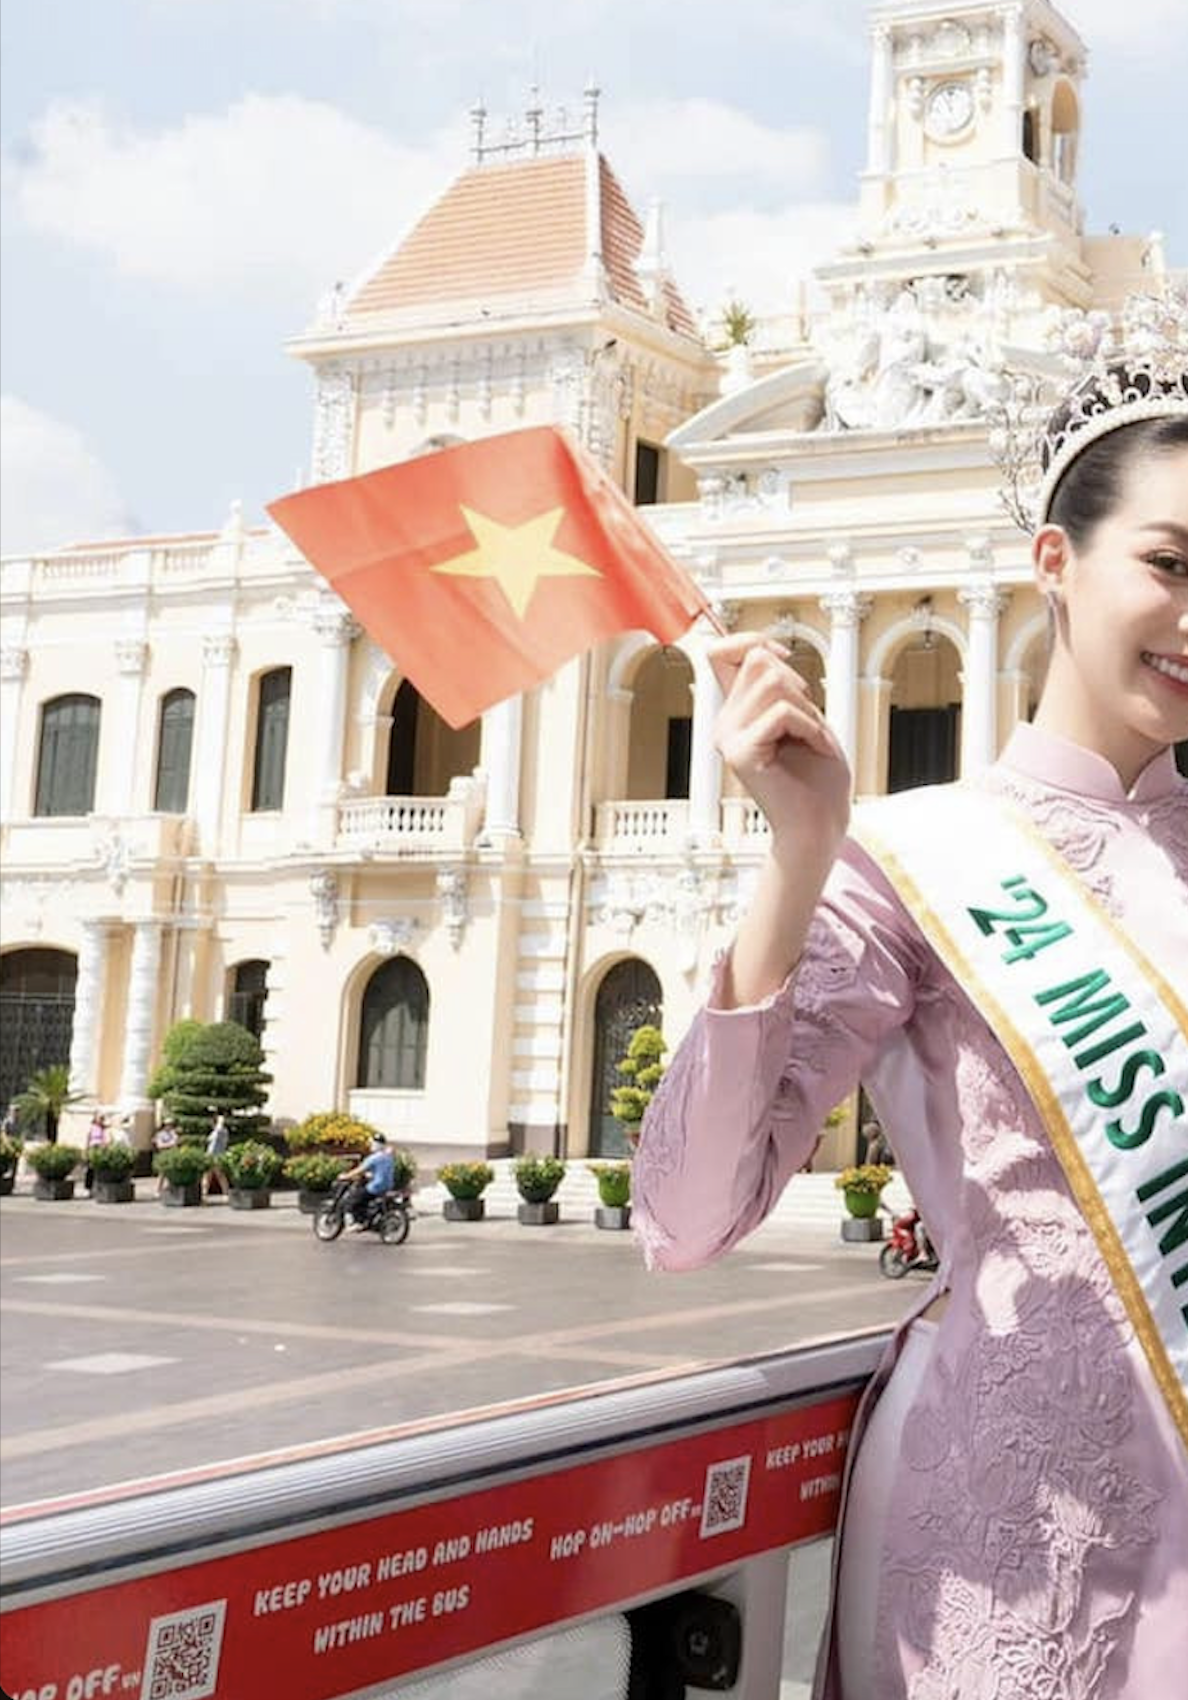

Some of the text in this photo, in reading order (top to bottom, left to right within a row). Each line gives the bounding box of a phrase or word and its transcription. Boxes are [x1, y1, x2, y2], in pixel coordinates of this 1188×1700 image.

[967, 874, 1075, 965] '24
[1033, 968, 1185, 1150] MISS
[550, 1529, 586, 1561] HOP
[660, 1498, 692, 1527] OFF
[254, 1518, 534, 1617] KEEP YOUR HEAD AND HANDS
[314, 1585, 470, 1654] WITHIN THE BUS
[66, 1664, 121, 1700] OFF
